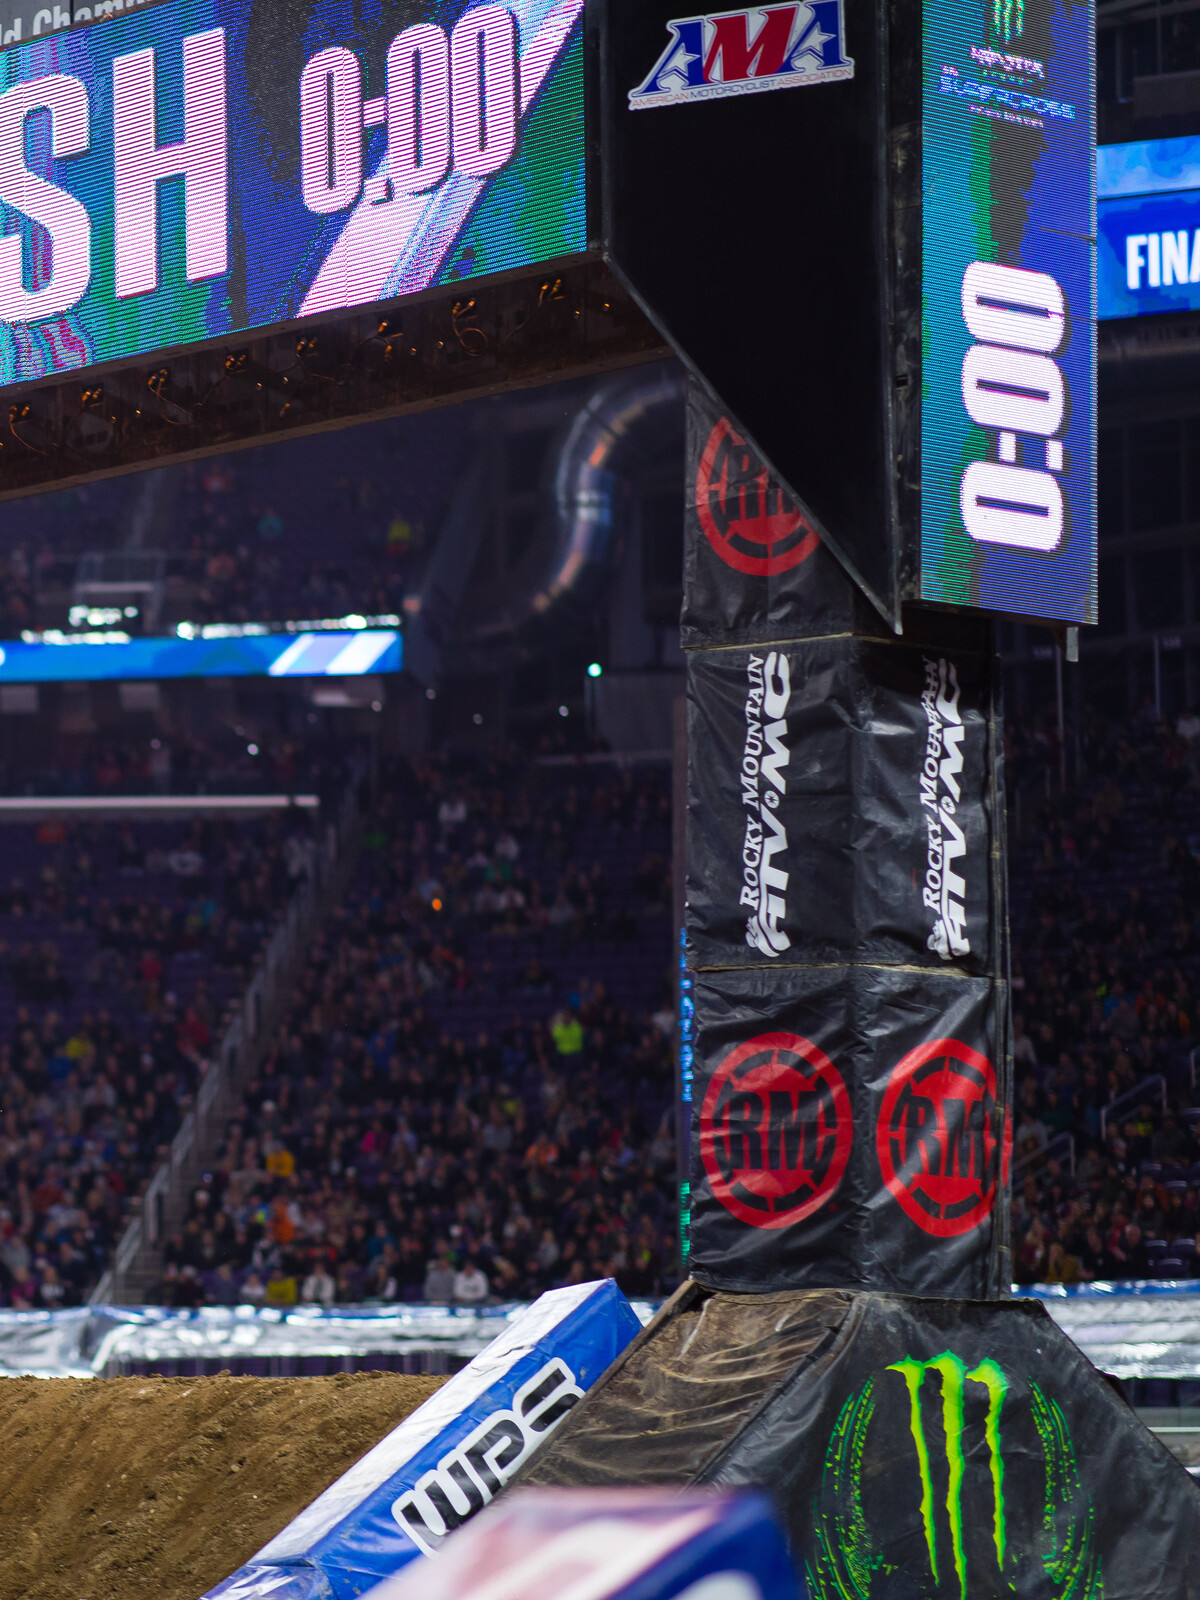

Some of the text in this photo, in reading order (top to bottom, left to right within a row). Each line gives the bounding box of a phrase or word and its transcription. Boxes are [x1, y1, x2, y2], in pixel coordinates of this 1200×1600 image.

[33, 0, 150, 35] Cham
[300, 4, 516, 214] 0:00
[630, 0, 852, 97] AMA
[632, 69, 852, 108] AMERICAN MOTORCYCLIST ASSOCIATION
[960, 260, 1065, 552] 0:00
[740, 653, 765, 911] ROCKY MOUNTAIN
[920, 654, 943, 914] ROCKY MOUNTAIN
[398, 1361, 585, 1555] WPS
